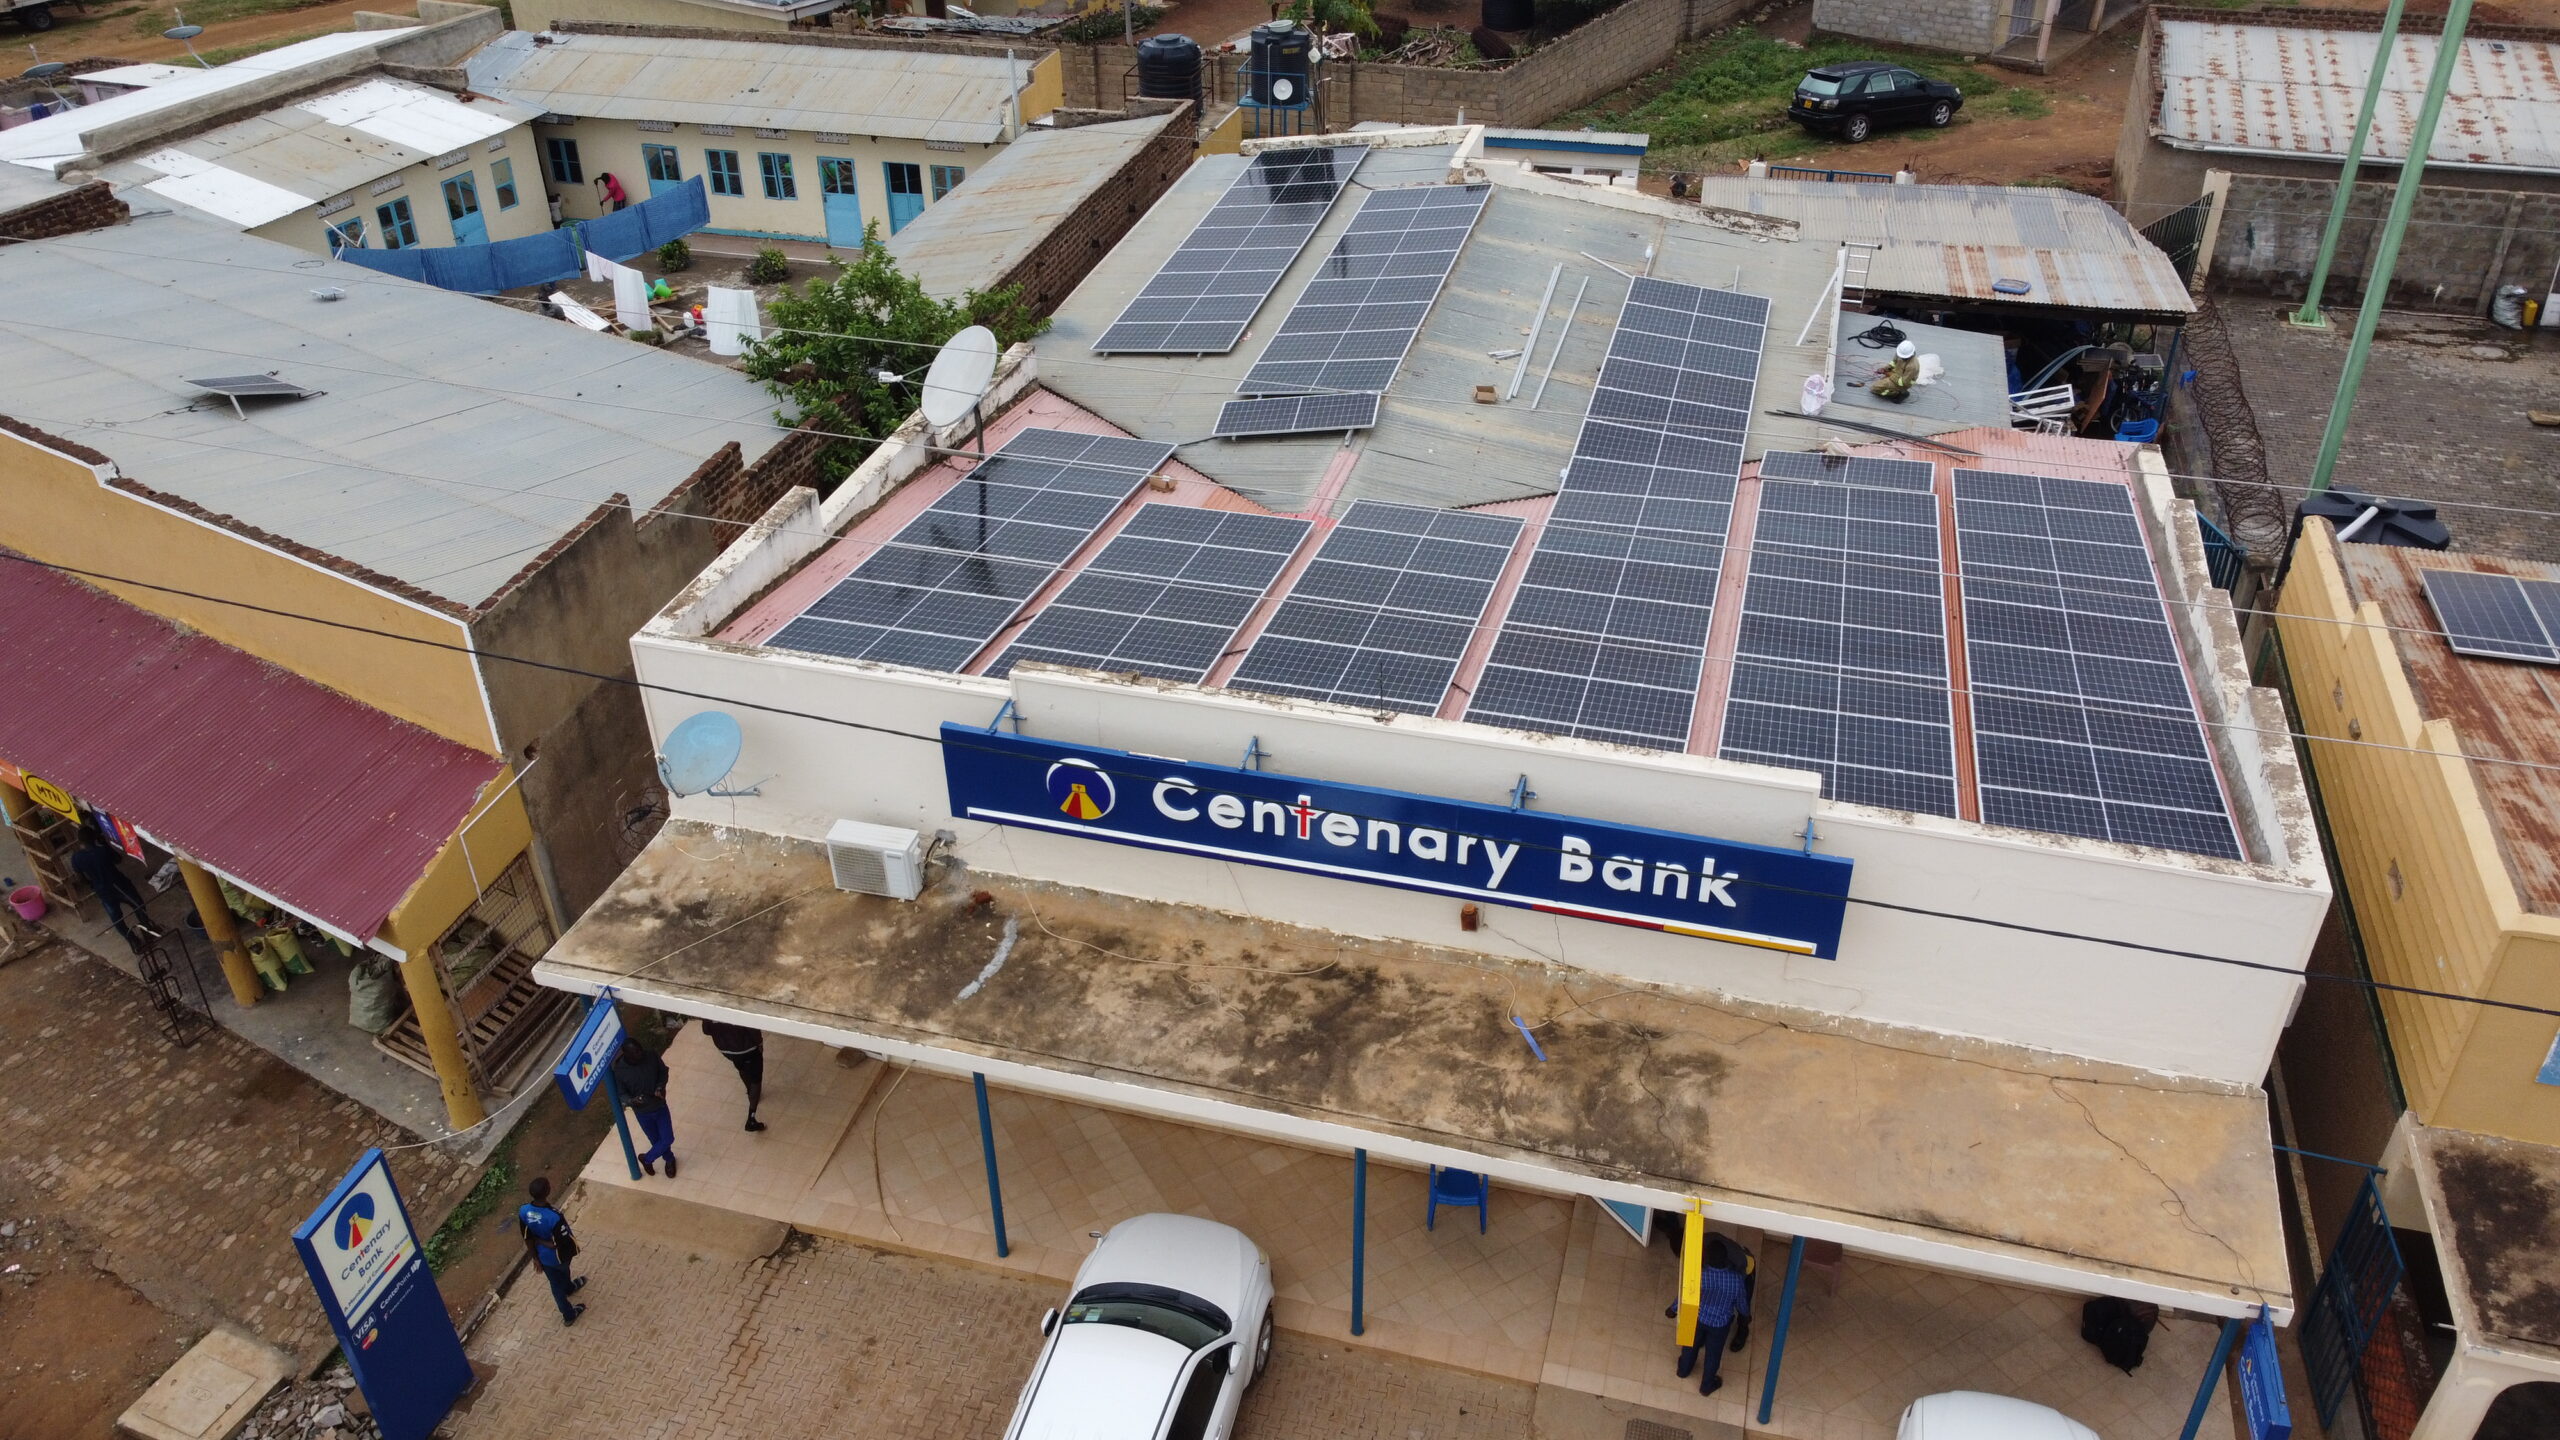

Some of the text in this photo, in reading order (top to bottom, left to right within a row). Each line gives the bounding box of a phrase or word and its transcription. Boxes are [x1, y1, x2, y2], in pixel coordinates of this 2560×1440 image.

[36, 784, 63, 805] MTN
[1152, 777, 1739, 908] Centenary Bank
[583, 1038, 618, 1093] CentePoint
[341, 1218, 391, 1280] Centenary
[358, 1246, 384, 1278] Bank
[380, 1271, 411, 1309] CentePoint
[355, 1315, 375, 1340] VISA
